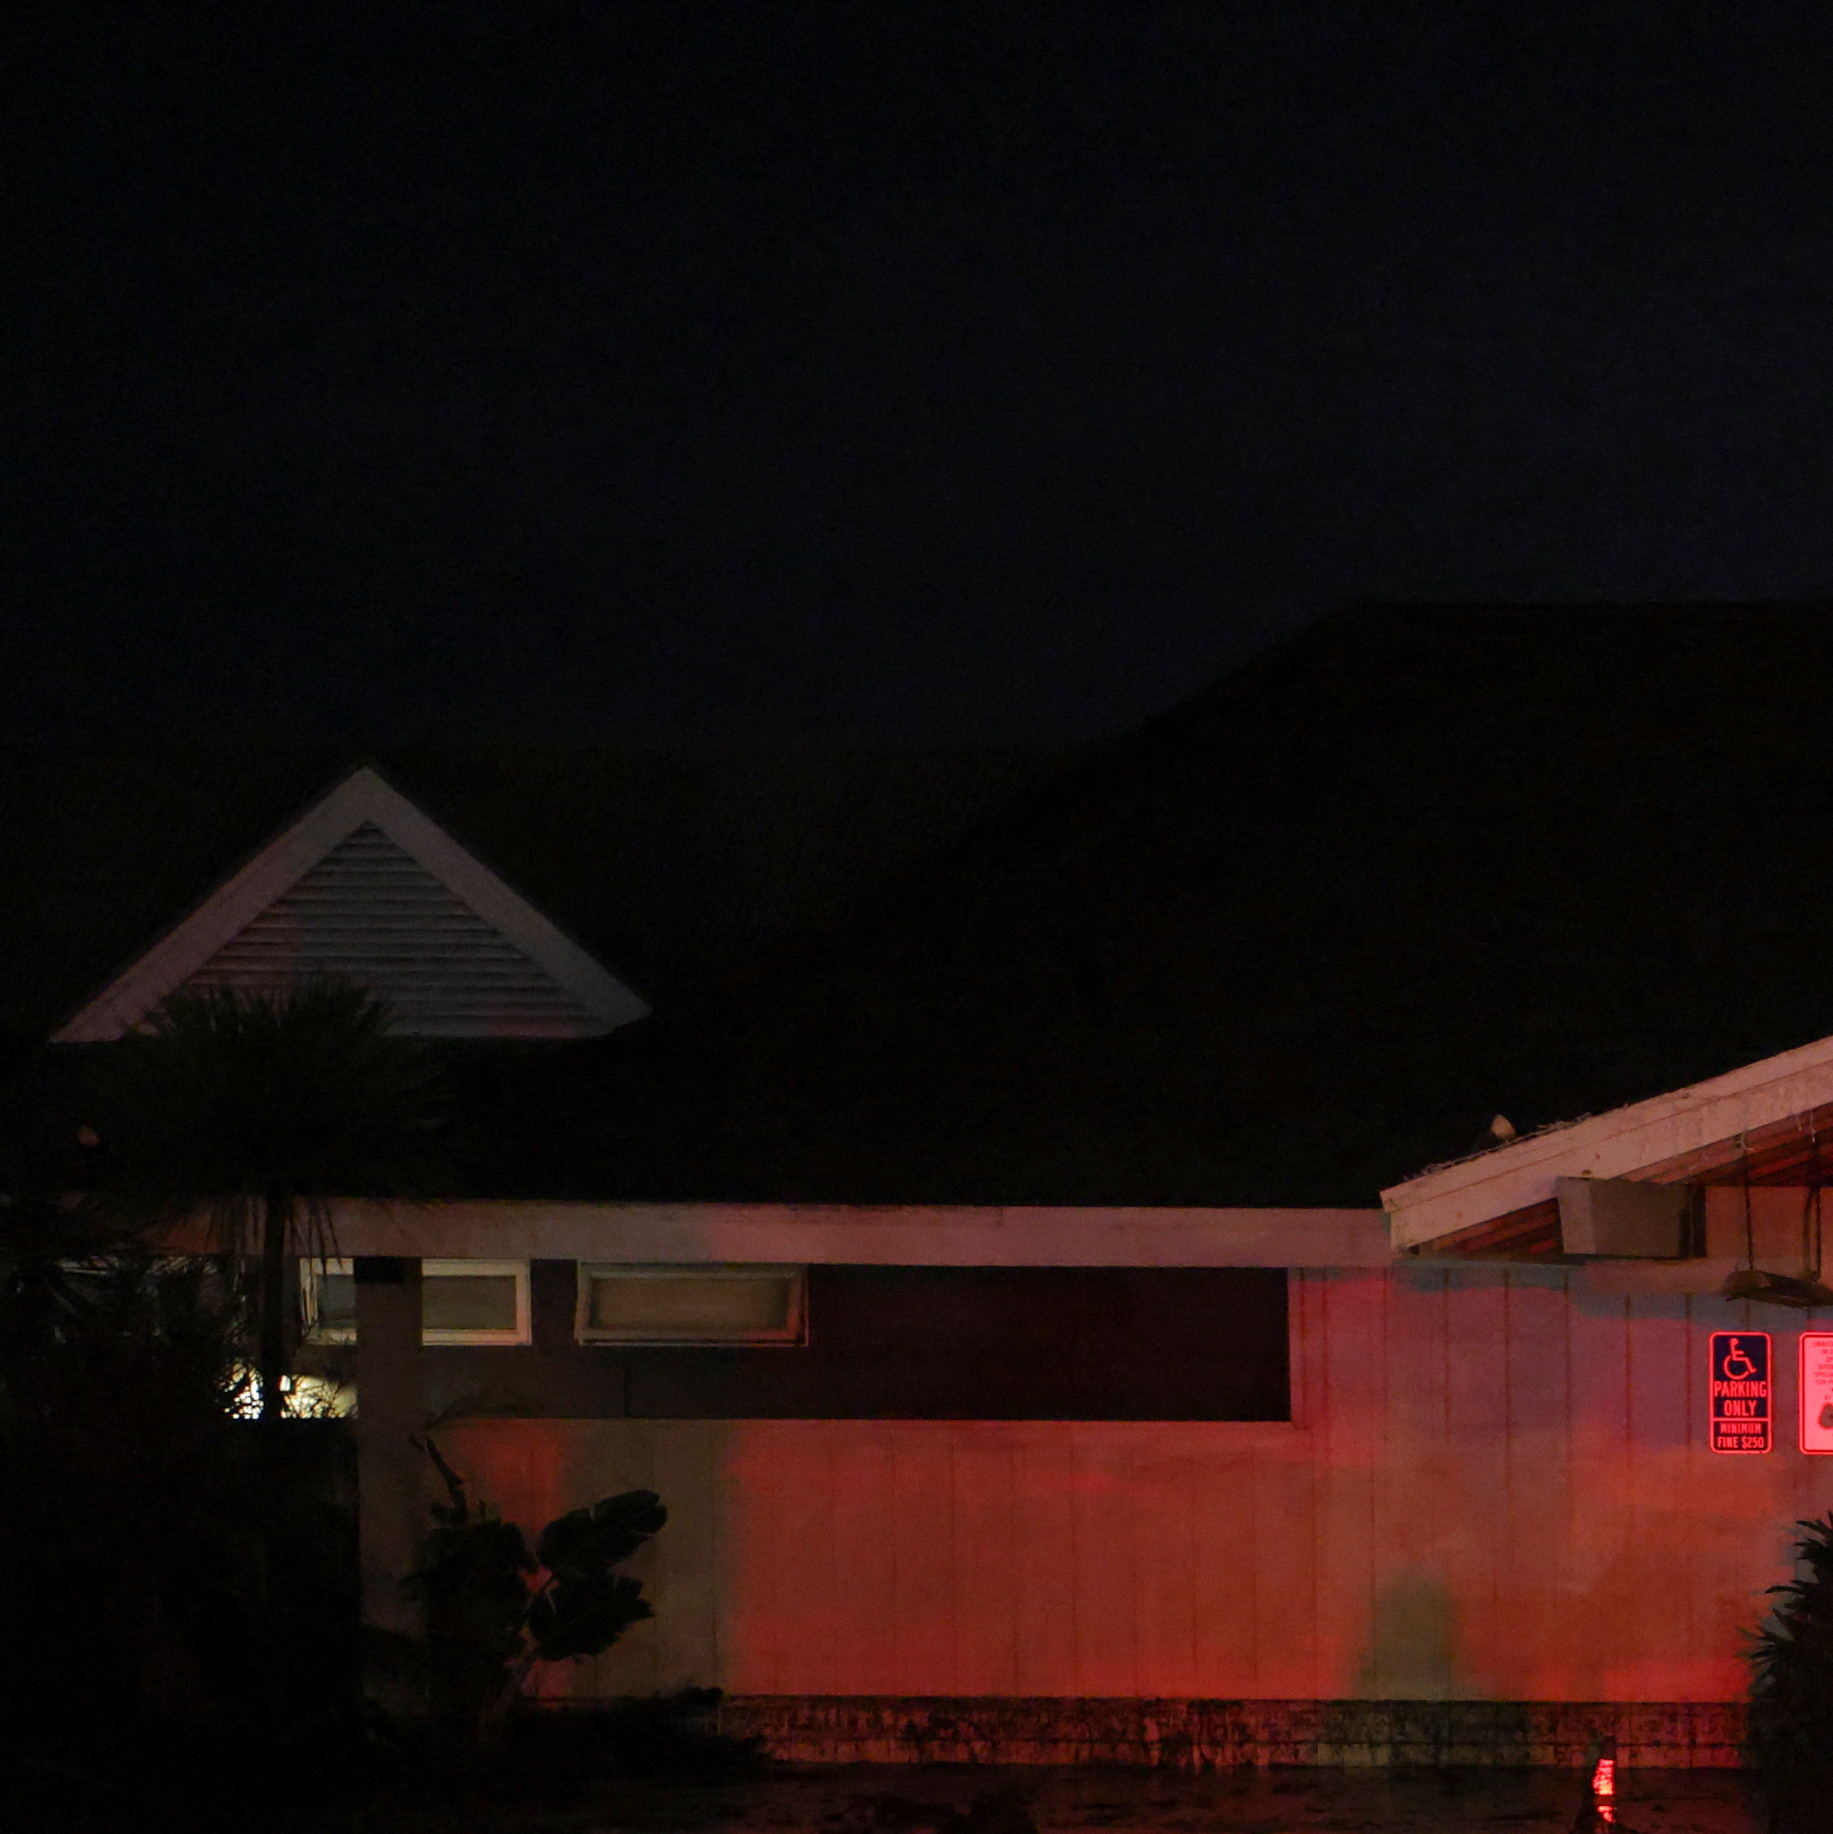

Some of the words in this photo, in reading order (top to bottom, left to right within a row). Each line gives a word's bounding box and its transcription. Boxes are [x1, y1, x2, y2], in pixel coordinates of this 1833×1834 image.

[1713, 1380, 1767, 1398] PARKING
[1723, 1399, 1757, 1417] ONLY
[1720, 1422, 1762, 1434] MINIMUM
[1717, 1436, 1739, 1449] FINE
[1741, 1435, 1764, 1450] $250
